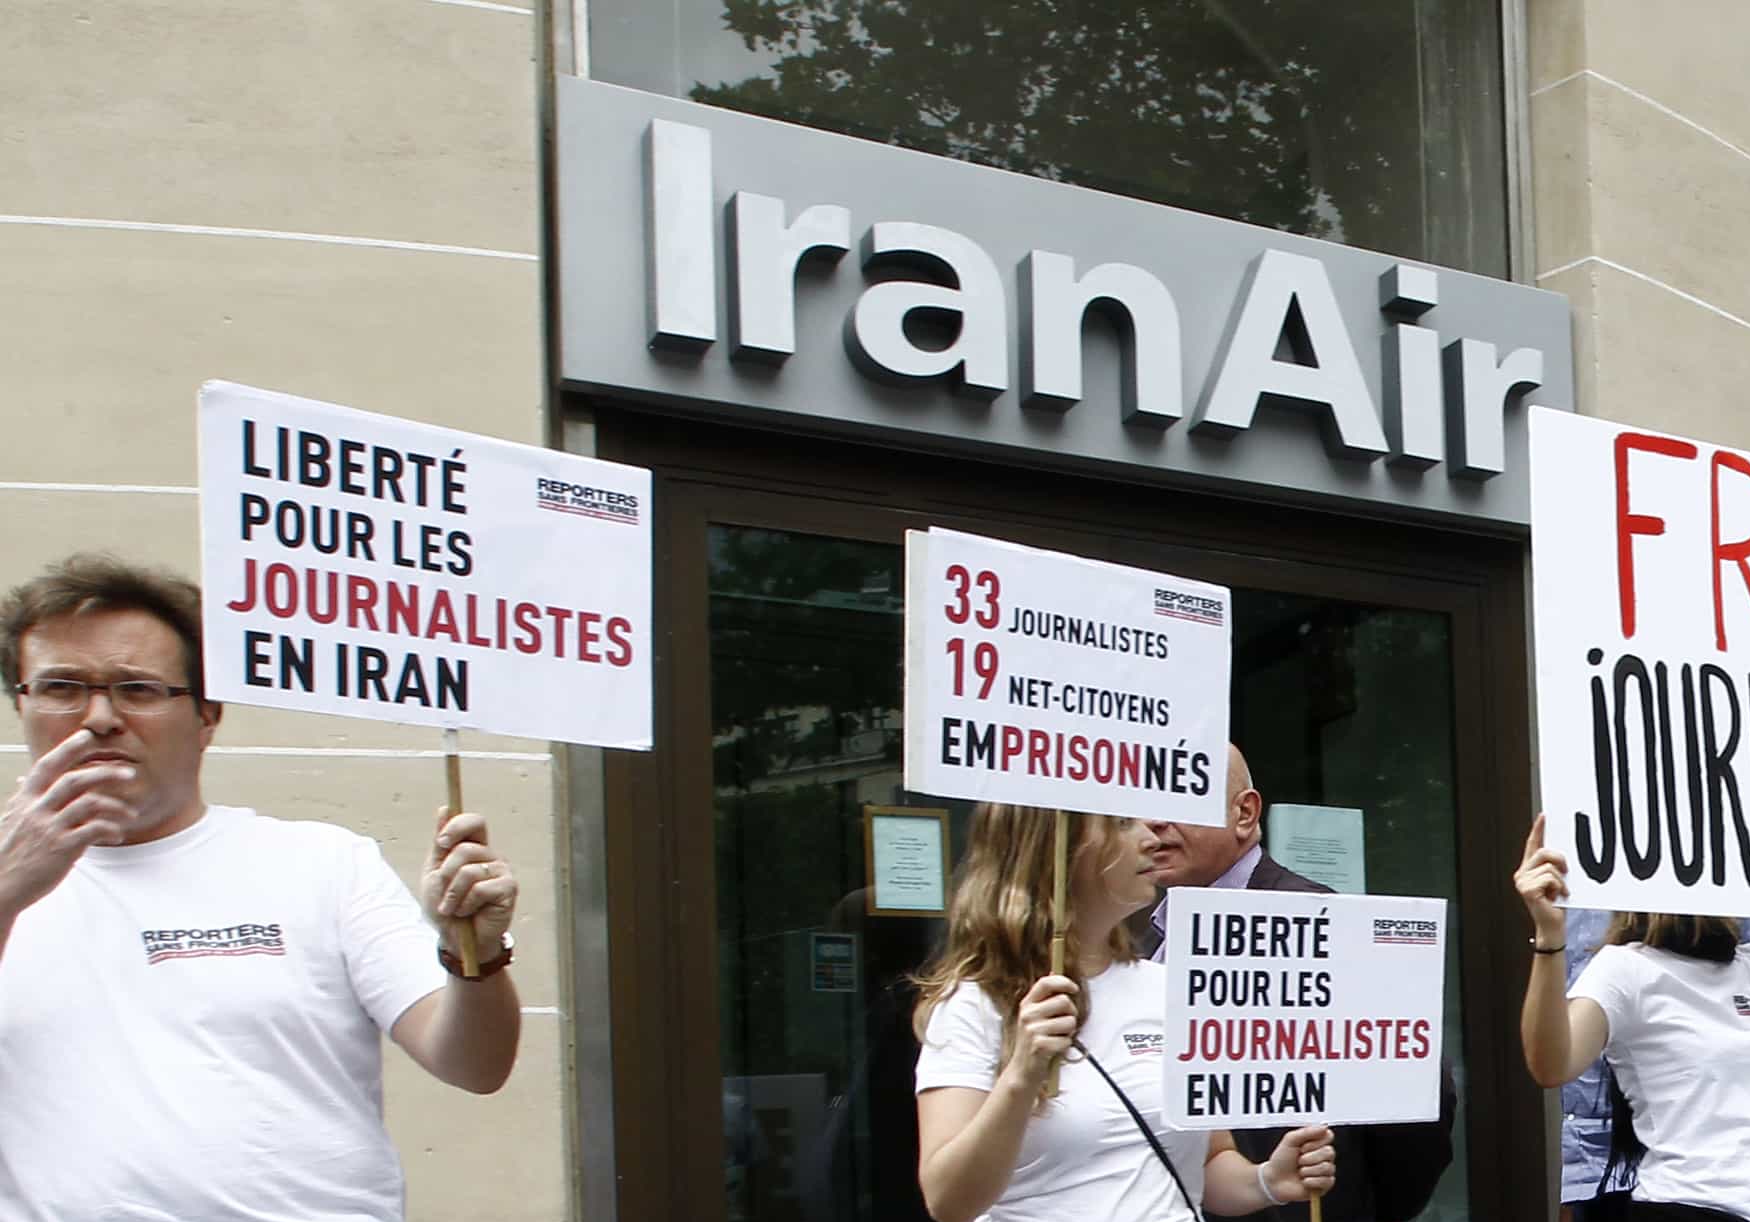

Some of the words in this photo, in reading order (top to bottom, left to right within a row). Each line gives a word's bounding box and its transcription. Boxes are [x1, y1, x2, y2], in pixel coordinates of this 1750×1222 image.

[242, 419, 468, 515] LIBERTÉ
[537, 477, 639, 509] REPORTERS
[240, 492, 376, 562] POUR
[393, 519, 474, 577] LES
[227, 558, 634, 668] JOURNALISTES
[944, 563, 1001, 630] 33
[1007, 606, 1169, 660] JOURNALISTES
[1154, 588, 1223, 612] REPORTERS
[244, 630, 315, 693] EN
[336, 642, 470, 713] IRAN
[946, 637, 1000, 701] 19
[1009, 675, 1170, 728] NET-CITOYENS
[940, 716, 1211, 798] EMPRISONNÉS
[142, 923, 282, 945] REPORTERS
[1191, 907, 1330, 959] LIBERTÉ
[1374, 919, 1437, 931] REPORTERS
[1188, 968, 1273, 1008] POUR
[1280, 971, 1331, 1008] LES
[1178, 1018, 1431, 1063] JOURNALISTES
[1187, 1073, 1230, 1117] EN
[1242, 1071, 1327, 1115] IRAN
